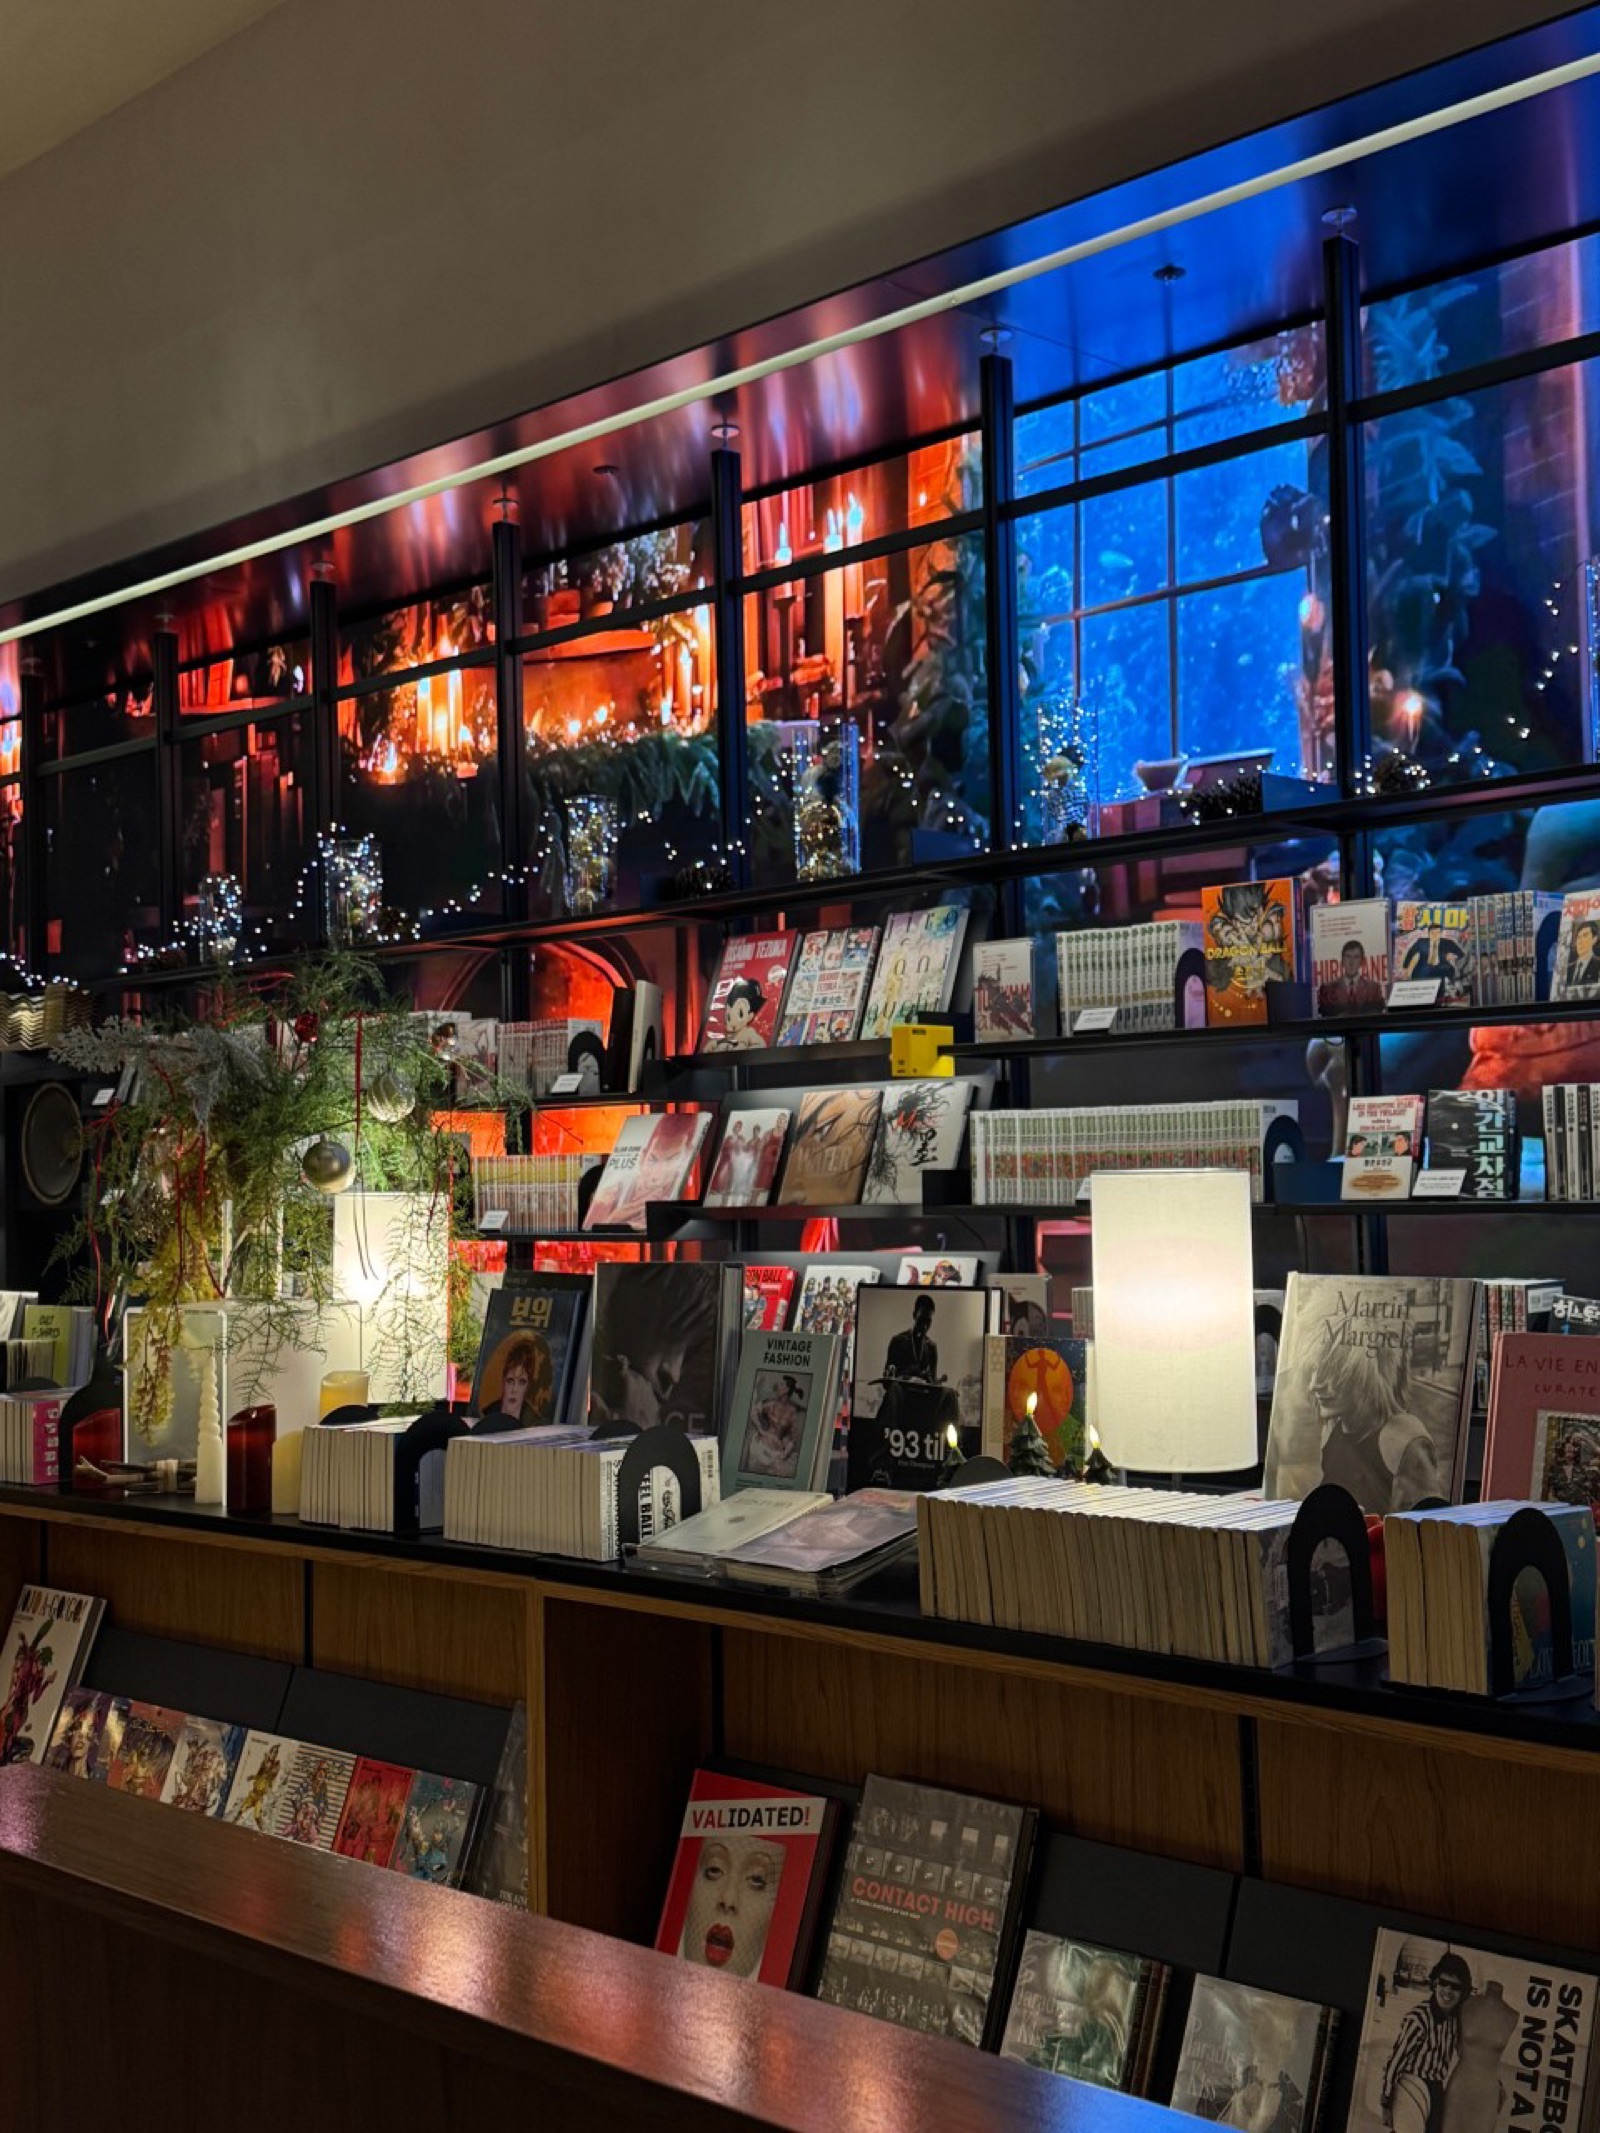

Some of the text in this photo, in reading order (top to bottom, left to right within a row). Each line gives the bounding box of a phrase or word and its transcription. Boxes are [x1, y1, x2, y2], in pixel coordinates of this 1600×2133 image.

[1312, 953, 1389, 986] HIRANE
[509, 1295, 553, 1328] 보위
[1331, 1289, 1411, 1319] Martin
[767, 1338, 813, 1353] VINTAGE
[1322, 1319, 1416, 1359] Margiela
[762, 1352, 811, 1367] FASHION
[1505, 1354, 1528, 1369] LA
[1574, 1359, 1599, 1375] EN
[692, 1805, 812, 1830] VALIDATED!
[852, 1876, 996, 1933] CONTACT HIGH
[1526, 1975, 1553, 2009] IS
[1516, 2014, 1548, 2092] NOT
[1510, 2091, 1536, 2118] A
